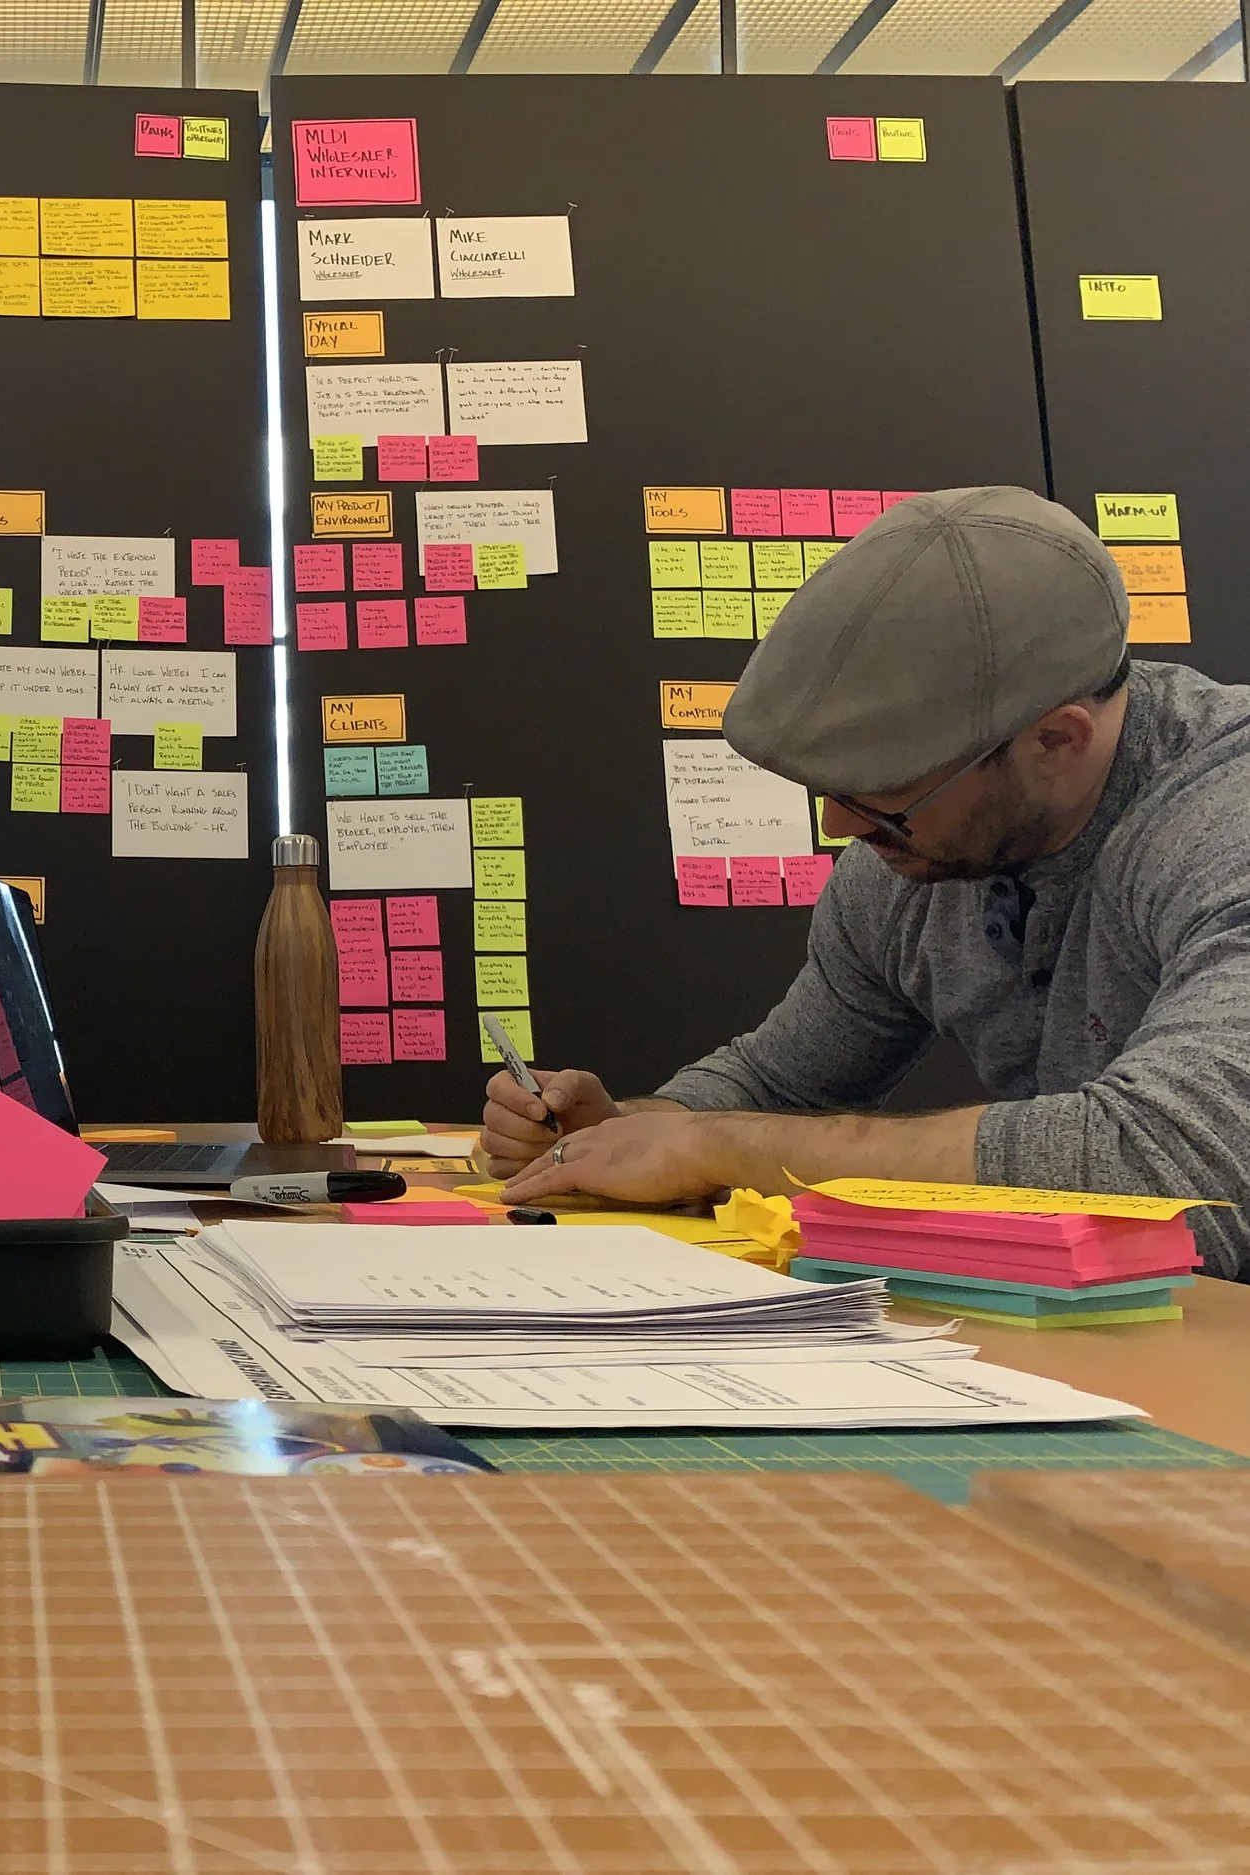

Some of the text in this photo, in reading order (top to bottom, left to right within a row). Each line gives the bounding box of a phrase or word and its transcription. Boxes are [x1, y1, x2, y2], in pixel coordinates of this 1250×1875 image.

[305, 129, 347, 145] MLDI
[307, 148, 398, 163] WHOLESALER
[310, 167, 397, 179] INTERVIEWS
[309, 229, 355, 246] MARK
[449, 229, 488, 244] MIKE
[311, 251, 396, 266] SCHNEIDER
[313, 269, 362, 280] WHOLESALER
[450, 268, 506, 279] WHOLESALER
[1088, 280, 1127, 293] INTRO
[309, 319, 359, 333] TYPICAL
[310, 335, 338, 349] DAY
[649, 492, 667, 502] MY
[316, 500, 335, 513] MY
[649, 506, 689, 517] TOOLS
[1104, 503, 1168, 517] WARM-UP
[316, 514, 388, 526] ENVIRONMENT
[92, 552, 108, 562] THE
[113, 552, 157, 561] EXTENSION
[113, 568, 159, 577] FEEL LIKE
[58, 587, 82, 596] WEEK
[17, 665, 30, 675] MY
[34, 667, 55, 676] OWN
[132, 667, 156, 677] LOVE
[160, 667, 191, 677] WEBEX
[10, 683, 21, 692] IT
[23, 685, 51, 693] UNDER
[65, 687, 84, 695] MINS
[109, 683, 141, 693] ALWAY
[145, 684, 163, 693] GET
[670, 687, 693, 701] MY
[130, 697, 163, 705] ALWAYS
[178, 698, 215, 707] MEETING
[330, 702, 354, 715] MY
[330, 718, 388, 731] CLIENTS
[165, 785, 237, 798] WANT SALES
[128, 802, 239, 817] PERSON RUNNING AROUND
[359, 811, 449, 822] HAVE TO SELL THE
[759, 817, 783, 826] LIFE
[128, 819, 147, 831] THE
[431, 823, 455, 833] THEN
